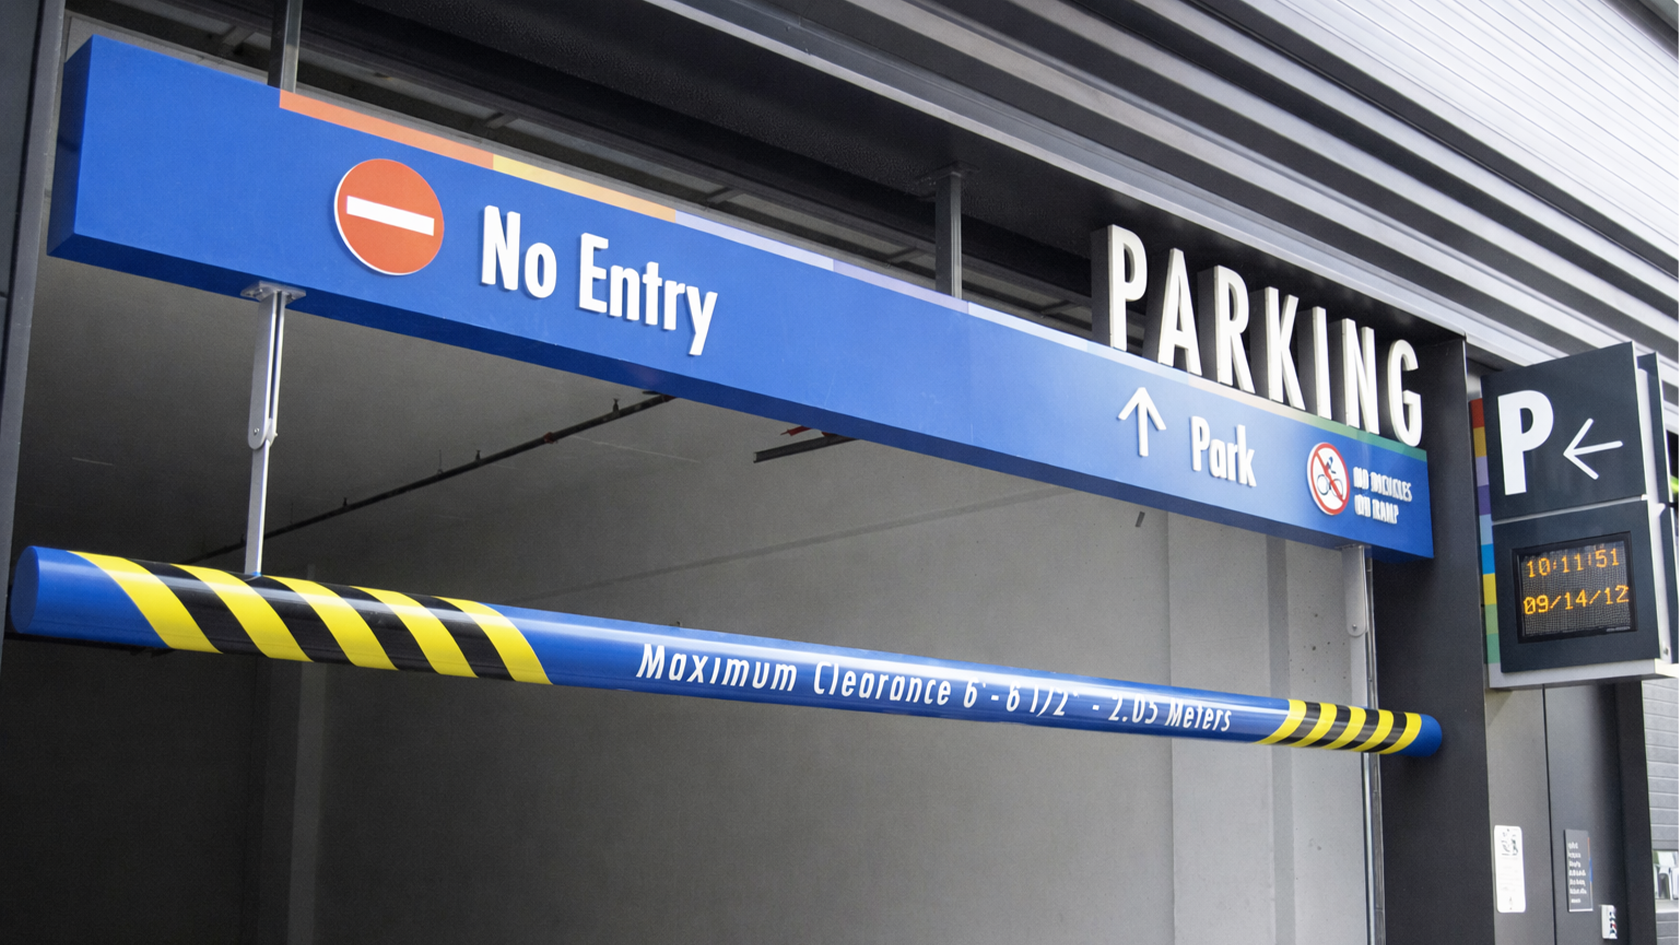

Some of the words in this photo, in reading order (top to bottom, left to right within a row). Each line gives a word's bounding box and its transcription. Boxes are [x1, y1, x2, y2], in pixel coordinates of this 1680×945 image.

[481, 205, 557, 298] No
[579, 233, 718, 356] Entry
[1106, 223, 1423, 447] PARKING
[1190, 415, 1257, 488] Park
[1497, 389, 1554, 496] P
[1523, 584, 1630, 615] 09/14/12
[1526, 547, 1620, 578] 10:11:51
[636, 643, 798, 692] Maximum
[813, 661, 951, 706] Clearance
[1108, 694, 1158, 724] 2.05
[1164, 697, 1233, 732] Meters
